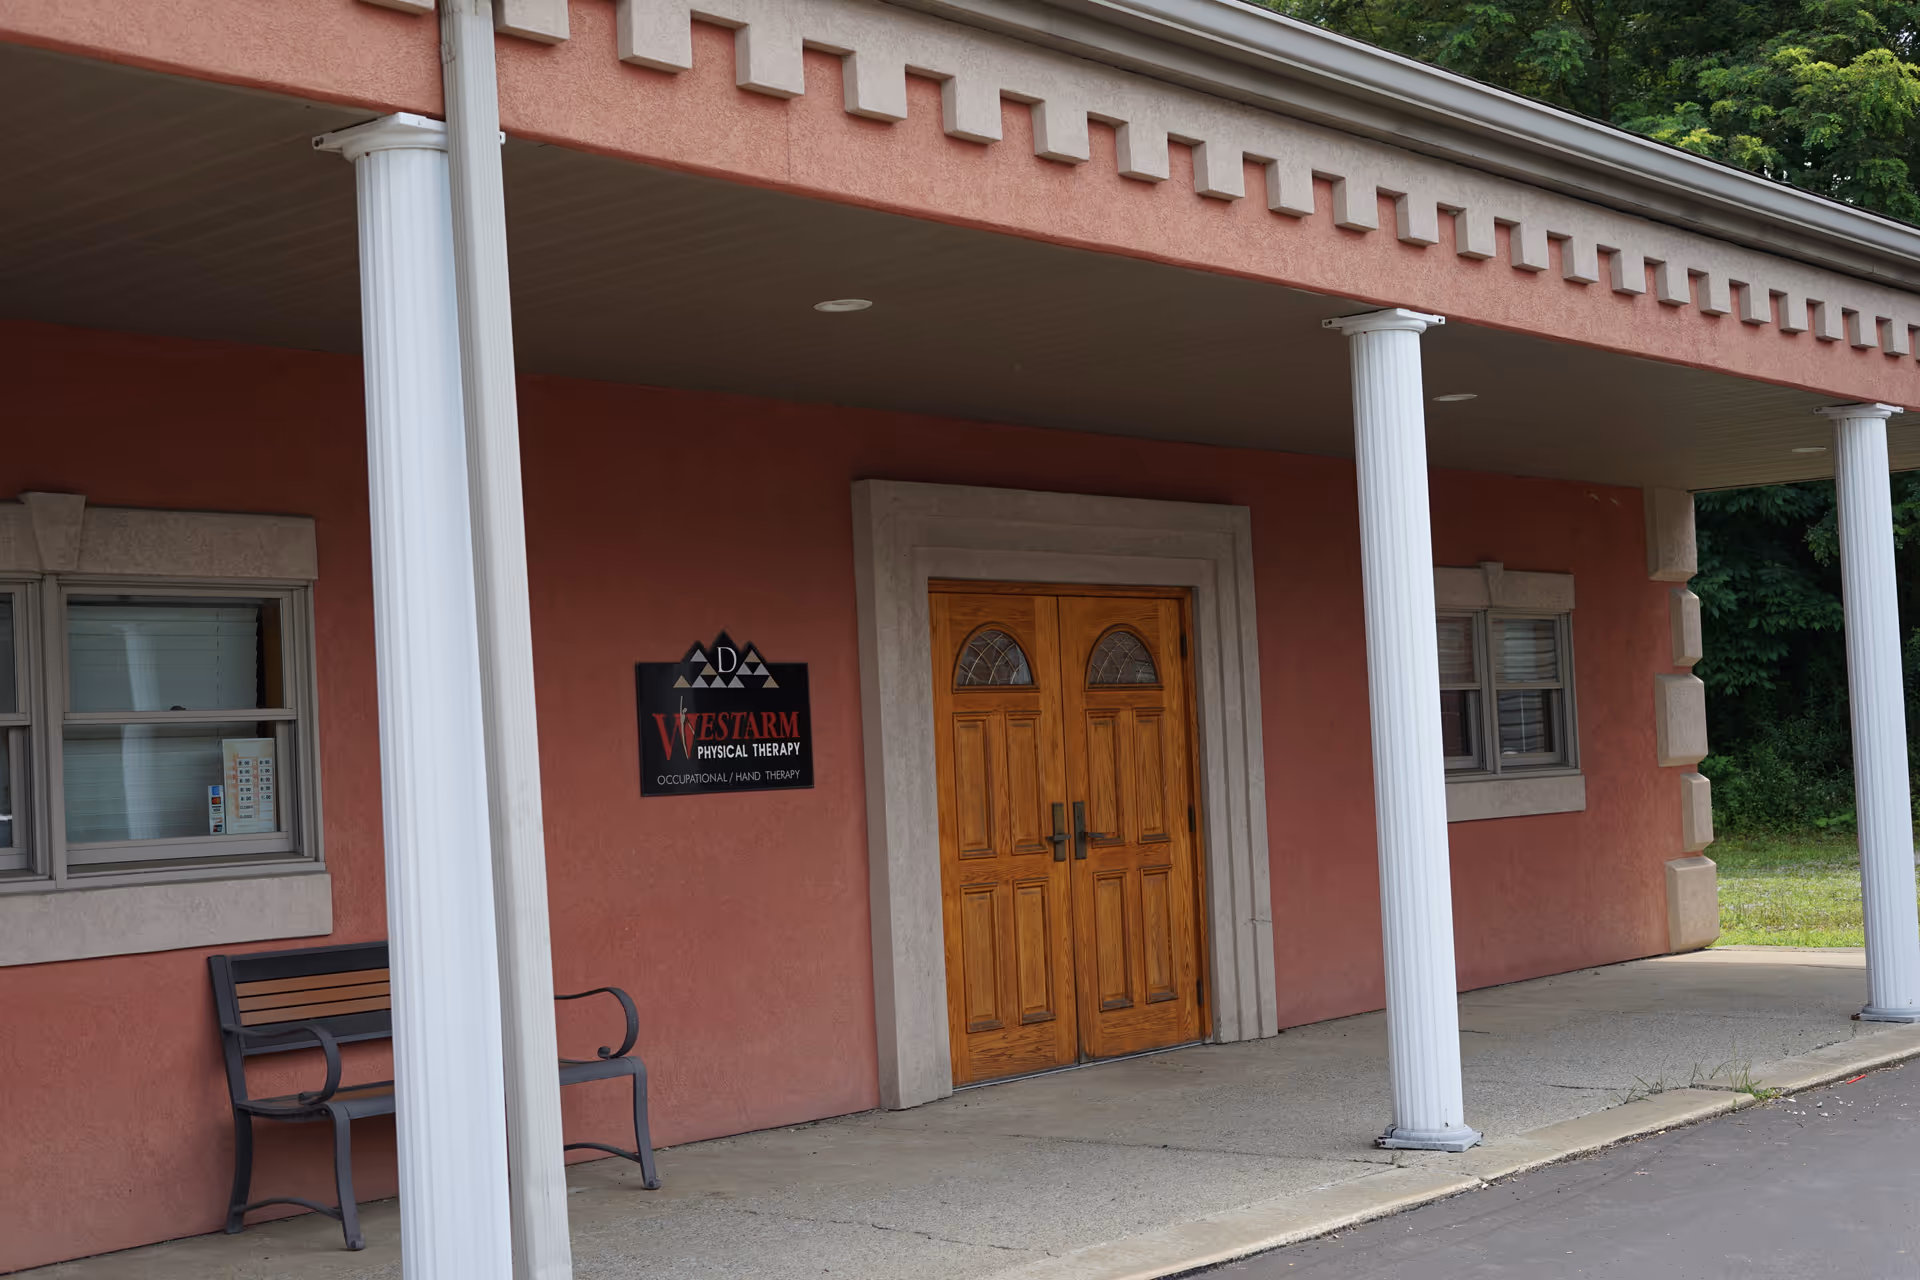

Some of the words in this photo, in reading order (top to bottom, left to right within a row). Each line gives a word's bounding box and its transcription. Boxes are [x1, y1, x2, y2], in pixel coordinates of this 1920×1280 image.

[717, 646, 737, 673] D
[652, 711, 800, 761] WESTARM
[697, 744, 748, 760] PHYSICAL
[752, 742, 800, 757] THERAPY
[657, 772, 728, 785] OCCUPATIONAL
[735, 771, 761, 781] HAND
[765, 769, 801, 780] THERAPY
